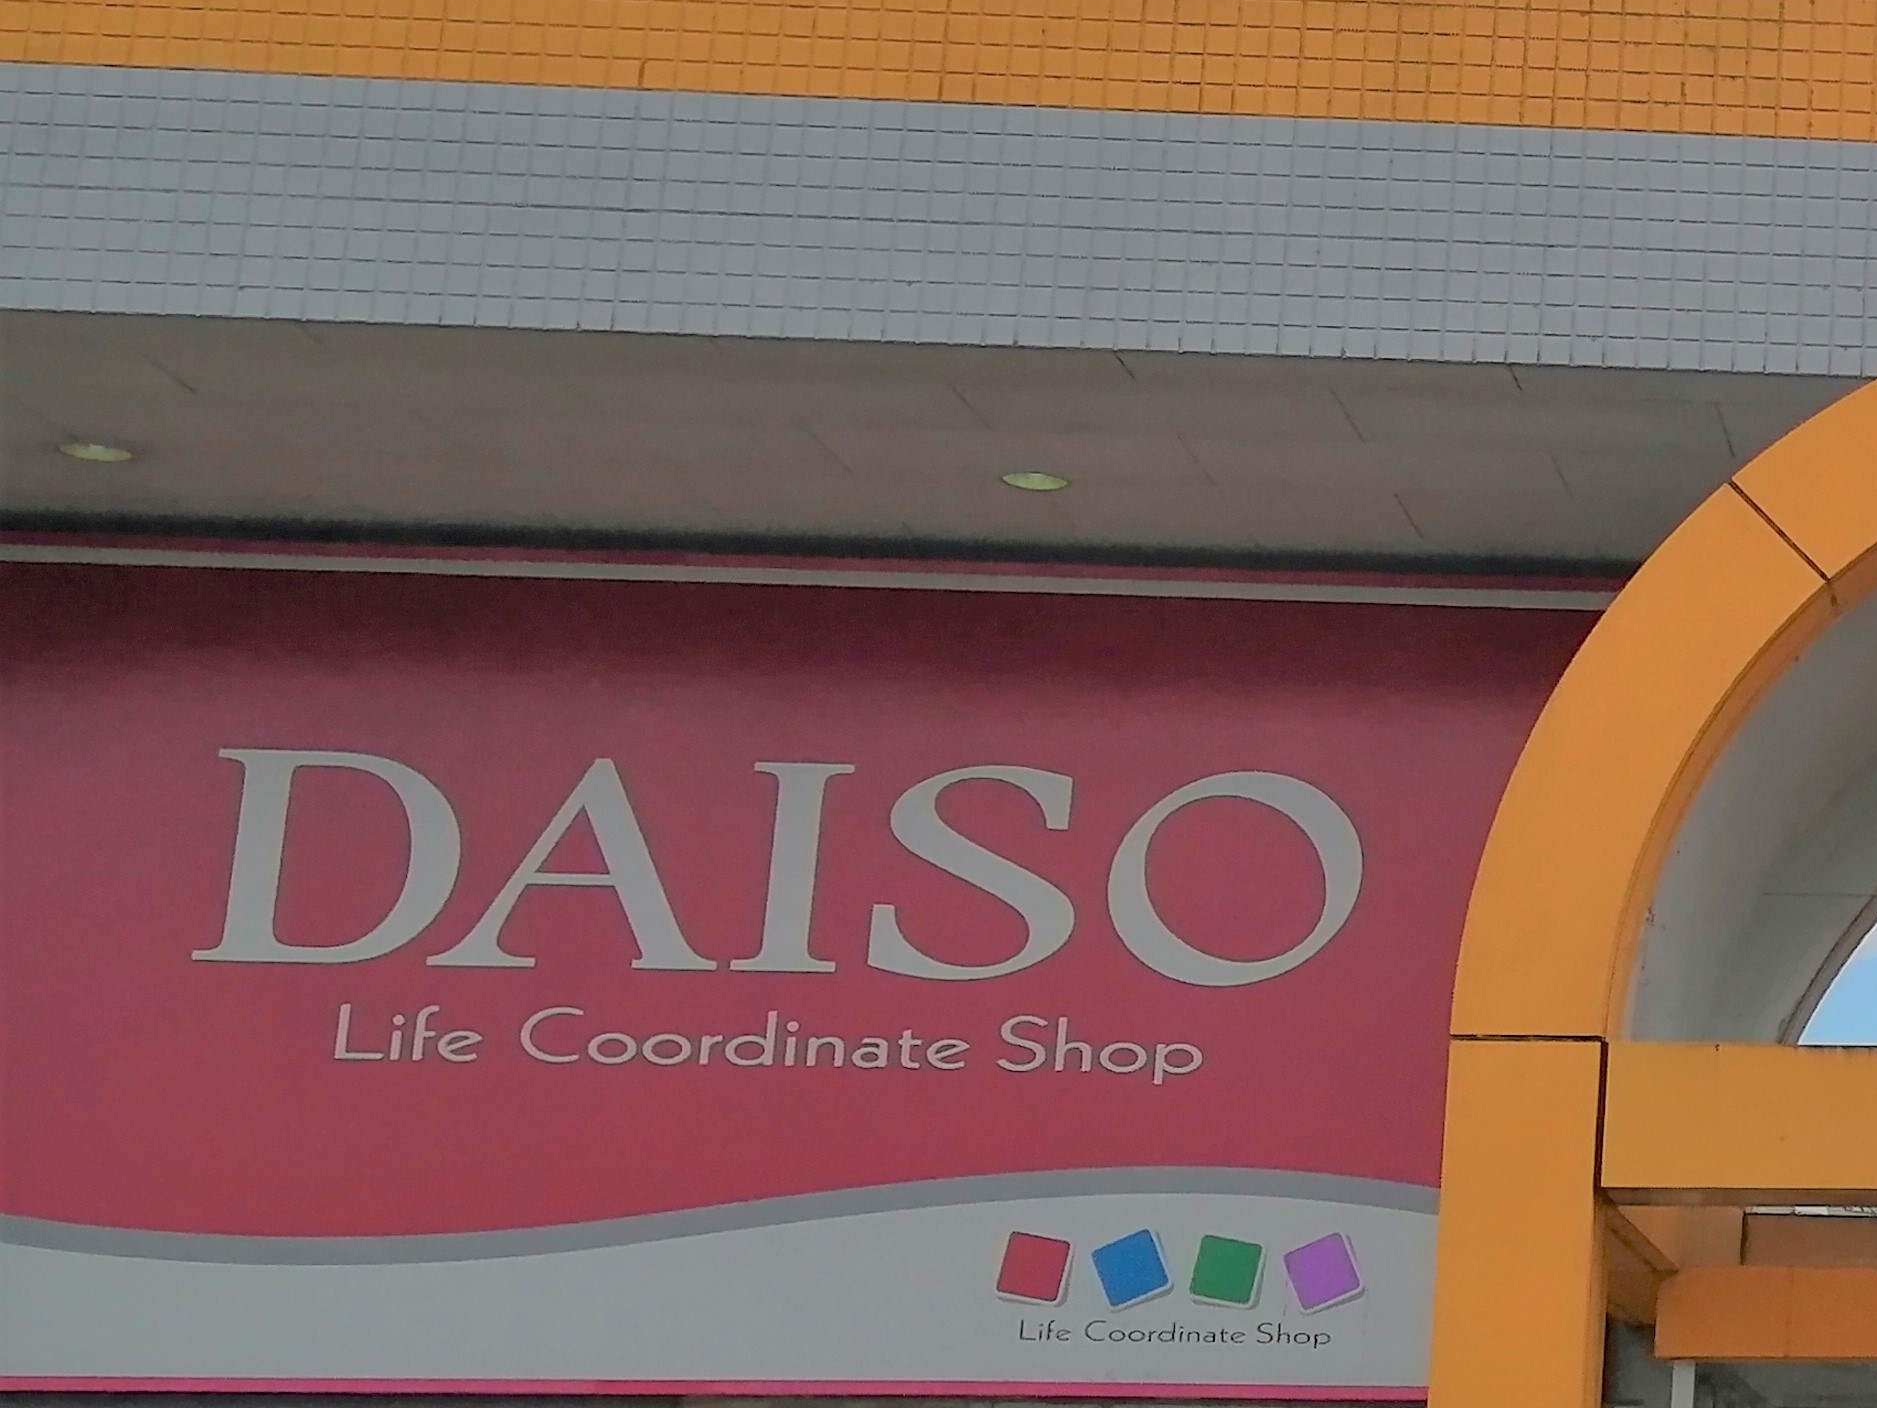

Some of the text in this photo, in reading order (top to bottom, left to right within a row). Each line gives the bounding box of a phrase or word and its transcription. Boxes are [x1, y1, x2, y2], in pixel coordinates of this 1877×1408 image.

[191, 747, 1364, 987] DAISO
[333, 1003, 1204, 1086] Life Coordinate Shop
[1018, 1319, 1333, 1349] Life Coordinate Shop
